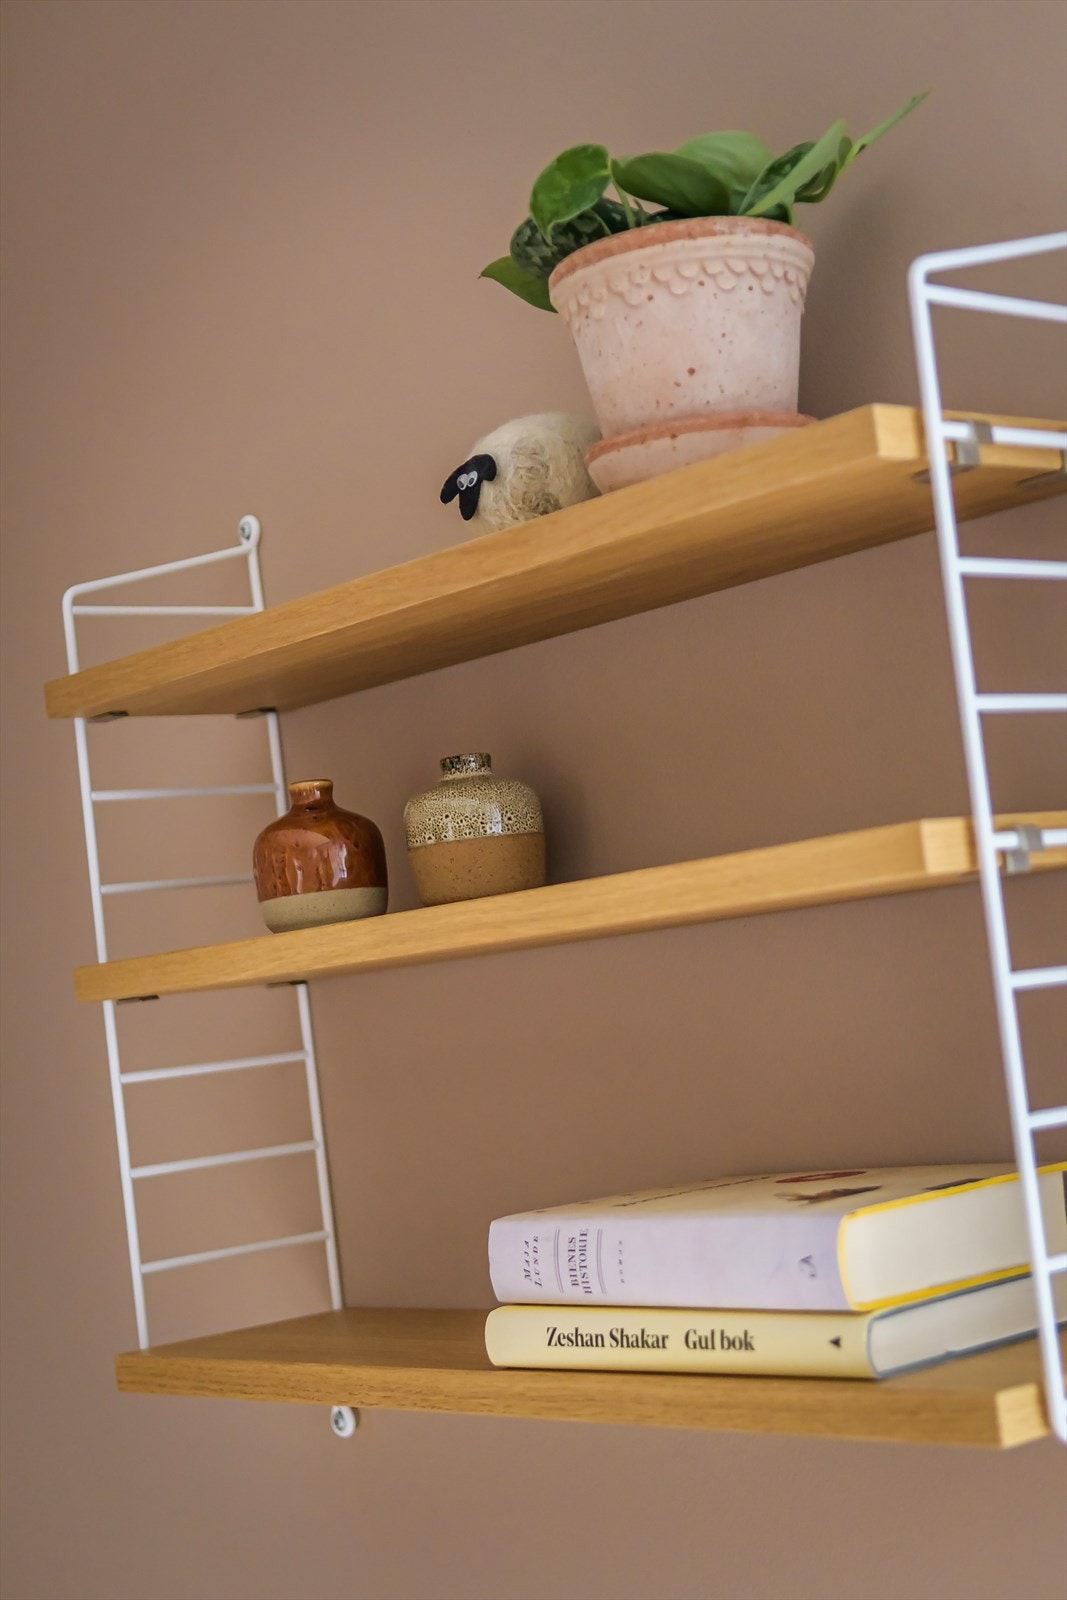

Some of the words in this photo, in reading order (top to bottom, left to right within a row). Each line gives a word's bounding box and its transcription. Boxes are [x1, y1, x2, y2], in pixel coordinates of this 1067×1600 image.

[567, 1236, 580, 1287] BIENES
[578, 1228, 592, 1294] HISTORIE
[546, 1326, 605, 1349] Zeshan
[608, 1327, 669, 1350] Shakar
[684, 1328, 716, 1351] Gul
[720, 1329, 756, 1351] bok
